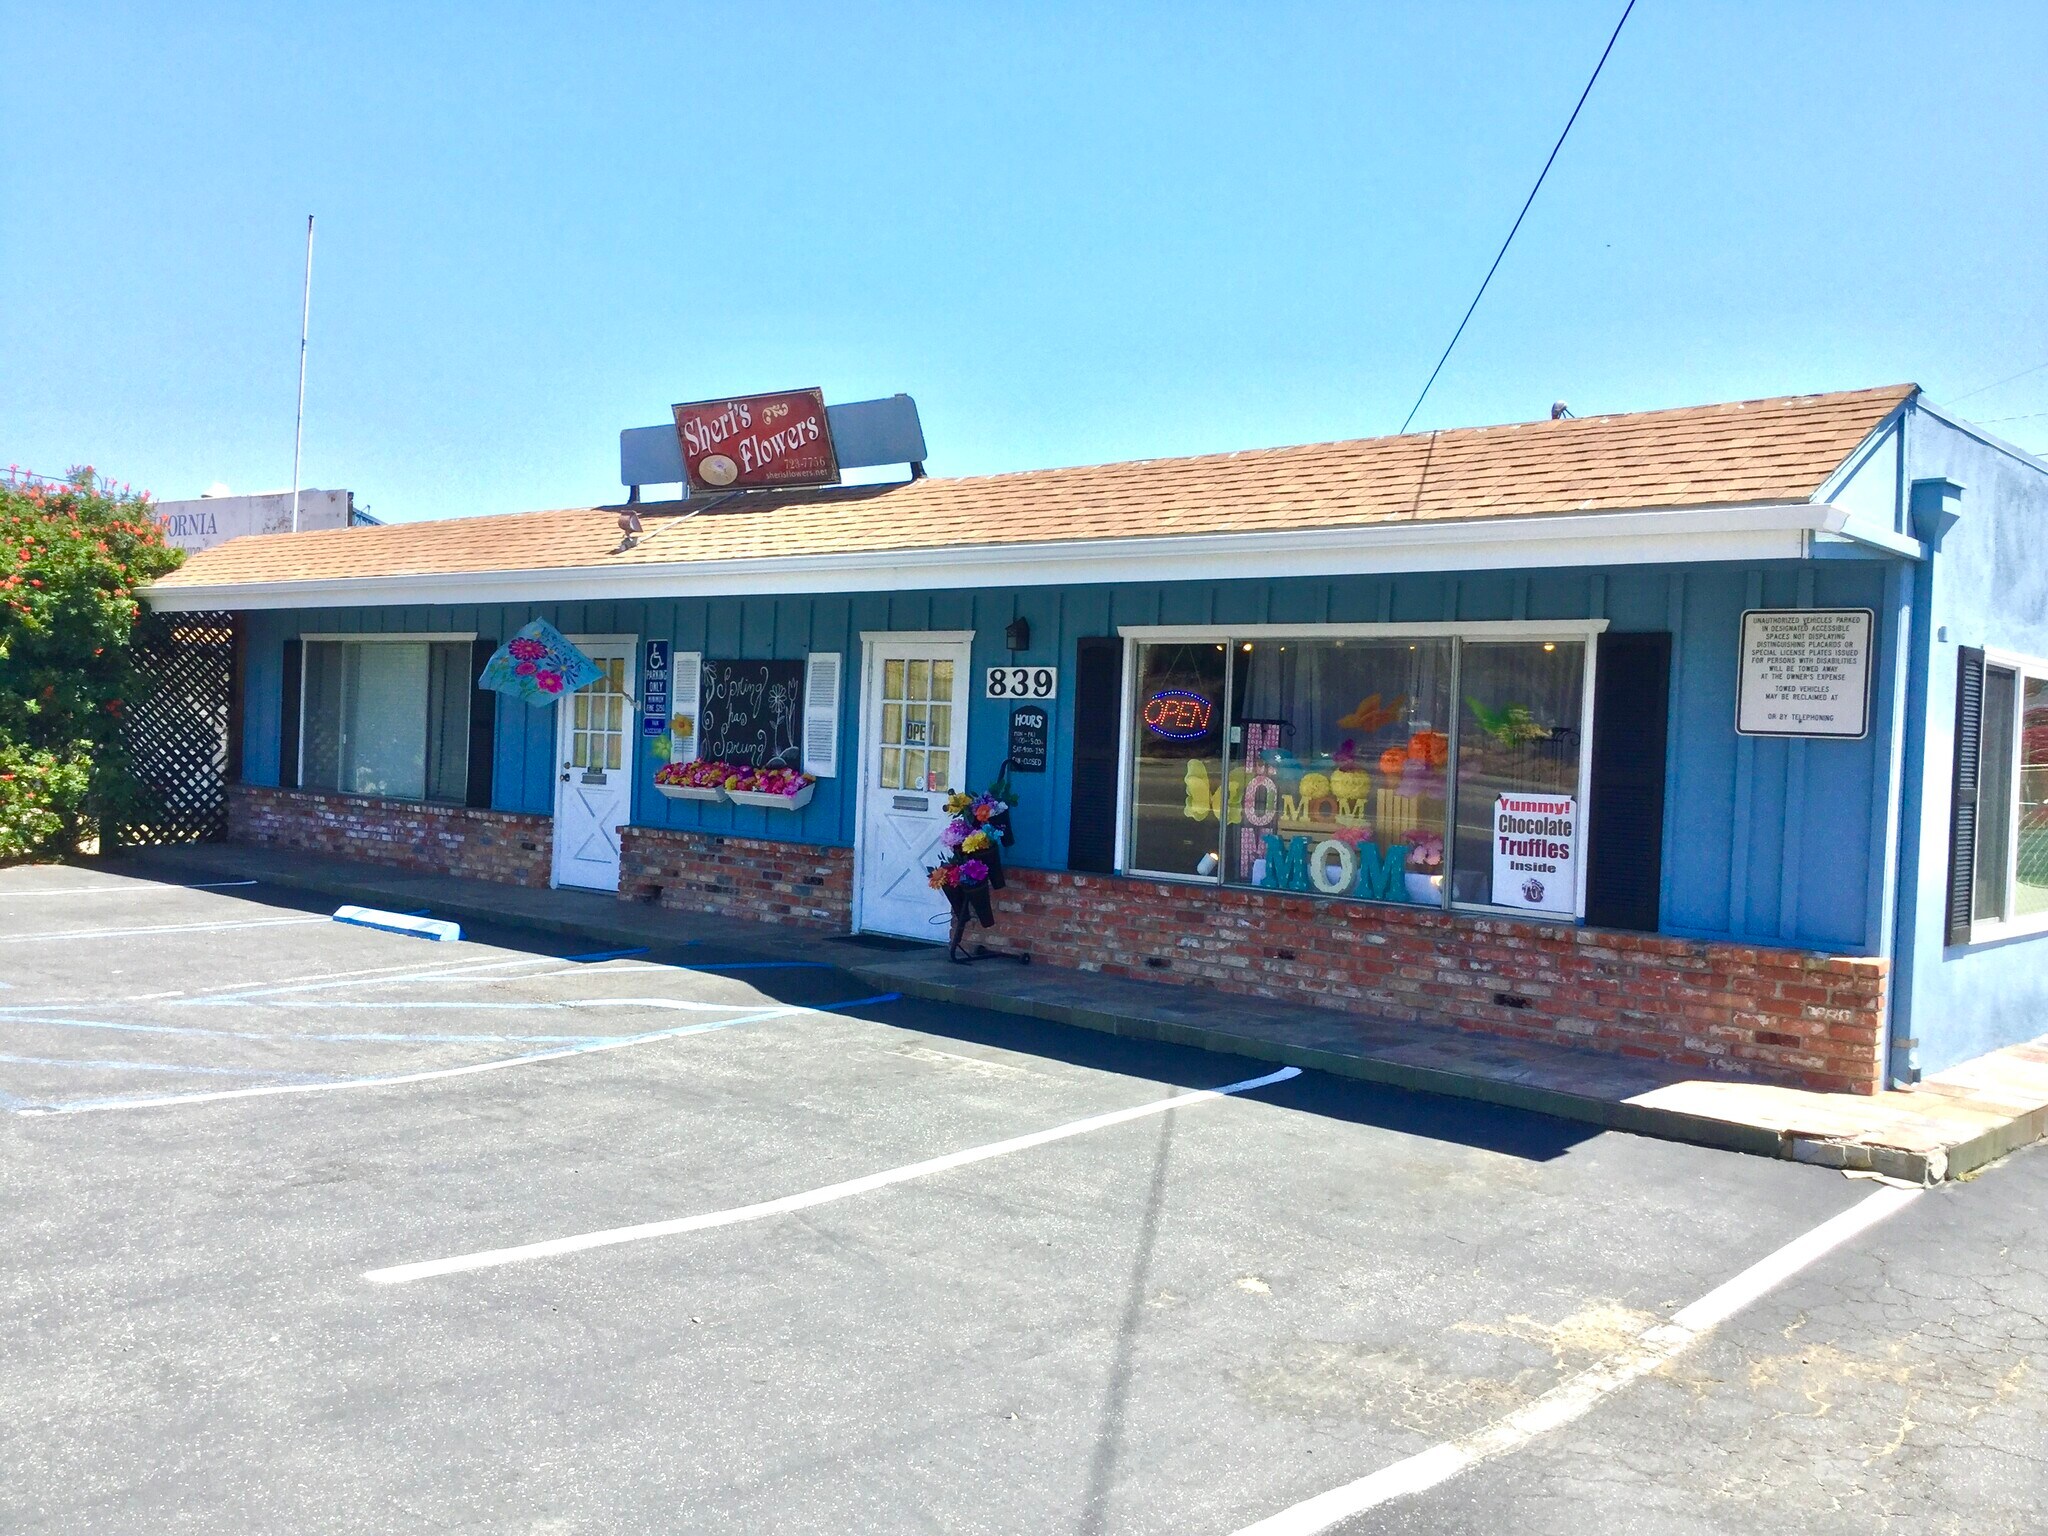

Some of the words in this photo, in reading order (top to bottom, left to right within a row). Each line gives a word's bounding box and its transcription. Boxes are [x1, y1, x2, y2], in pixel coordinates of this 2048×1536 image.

[684, 402, 752, 457] Sheri's
[738, 416, 819, 473] Flowers
[766, 469, 828, 480] sherisflowers.net
[649, 682, 663, 692] ONLY
[717, 667, 768, 718] Spring
[989, 669, 1053, 697] 839
[728, 703, 747, 728] has
[1015, 714, 1043, 728] HOURS
[1144, 700, 1212, 728] OPEN
[713, 723, 767, 766] Sprung
[907, 723, 926, 741] OPE
[1281, 794, 1368, 822] MOM
[1500, 799, 1570, 815] Yummy!
[1499, 815, 1572, 836] Chocolate
[1499, 836, 1570, 859] Truffles
[1261, 834, 1412, 902] MOM
[1510, 861, 1556, 873] Inside
